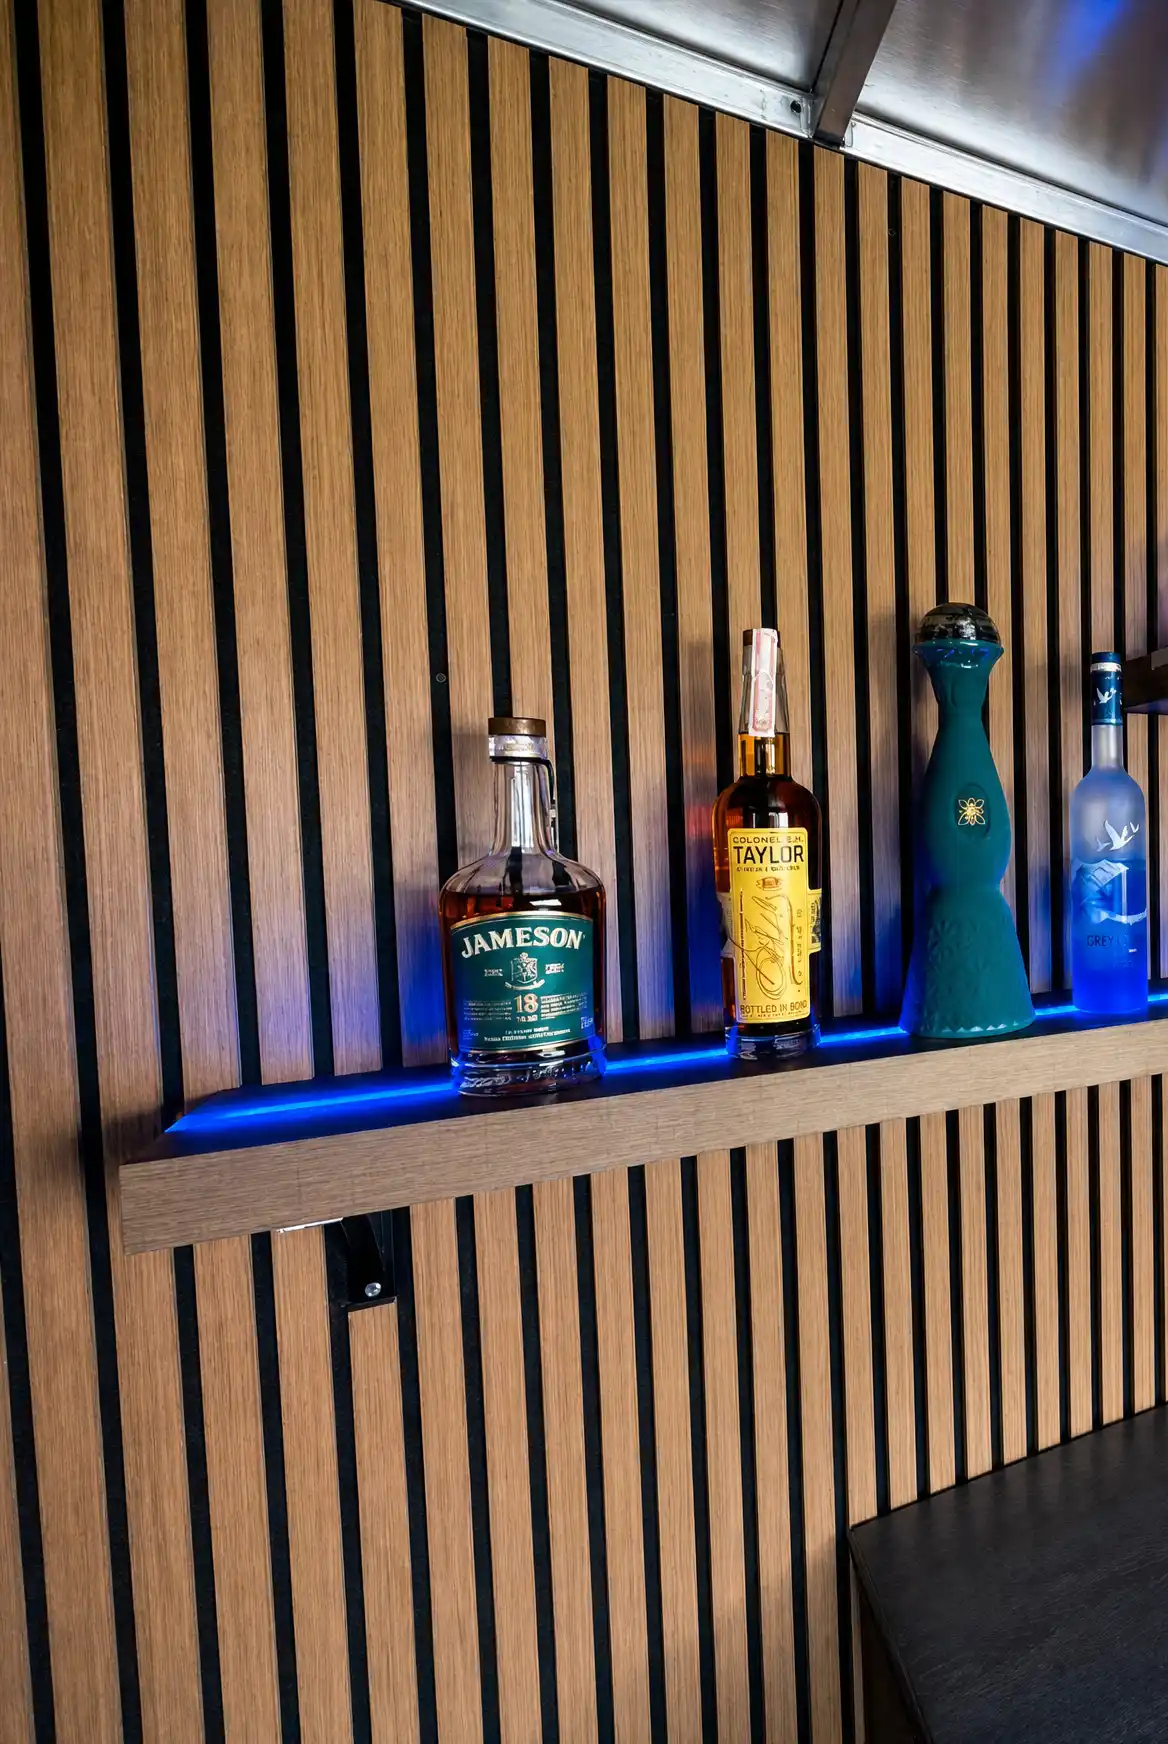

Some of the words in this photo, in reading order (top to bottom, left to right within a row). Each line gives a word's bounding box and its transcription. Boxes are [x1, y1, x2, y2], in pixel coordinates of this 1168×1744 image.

[732, 836, 782, 844] COLONEL
[733, 845, 804, 864] TAYLOR
[461, 926, 583, 959] JAMESON
[1087, 934, 1114, 947] GREY
[514, 993, 539, 1013] 18
[740, 1004, 777, 1015] BOTTLED
[780, 1003, 788, 1012] IN
